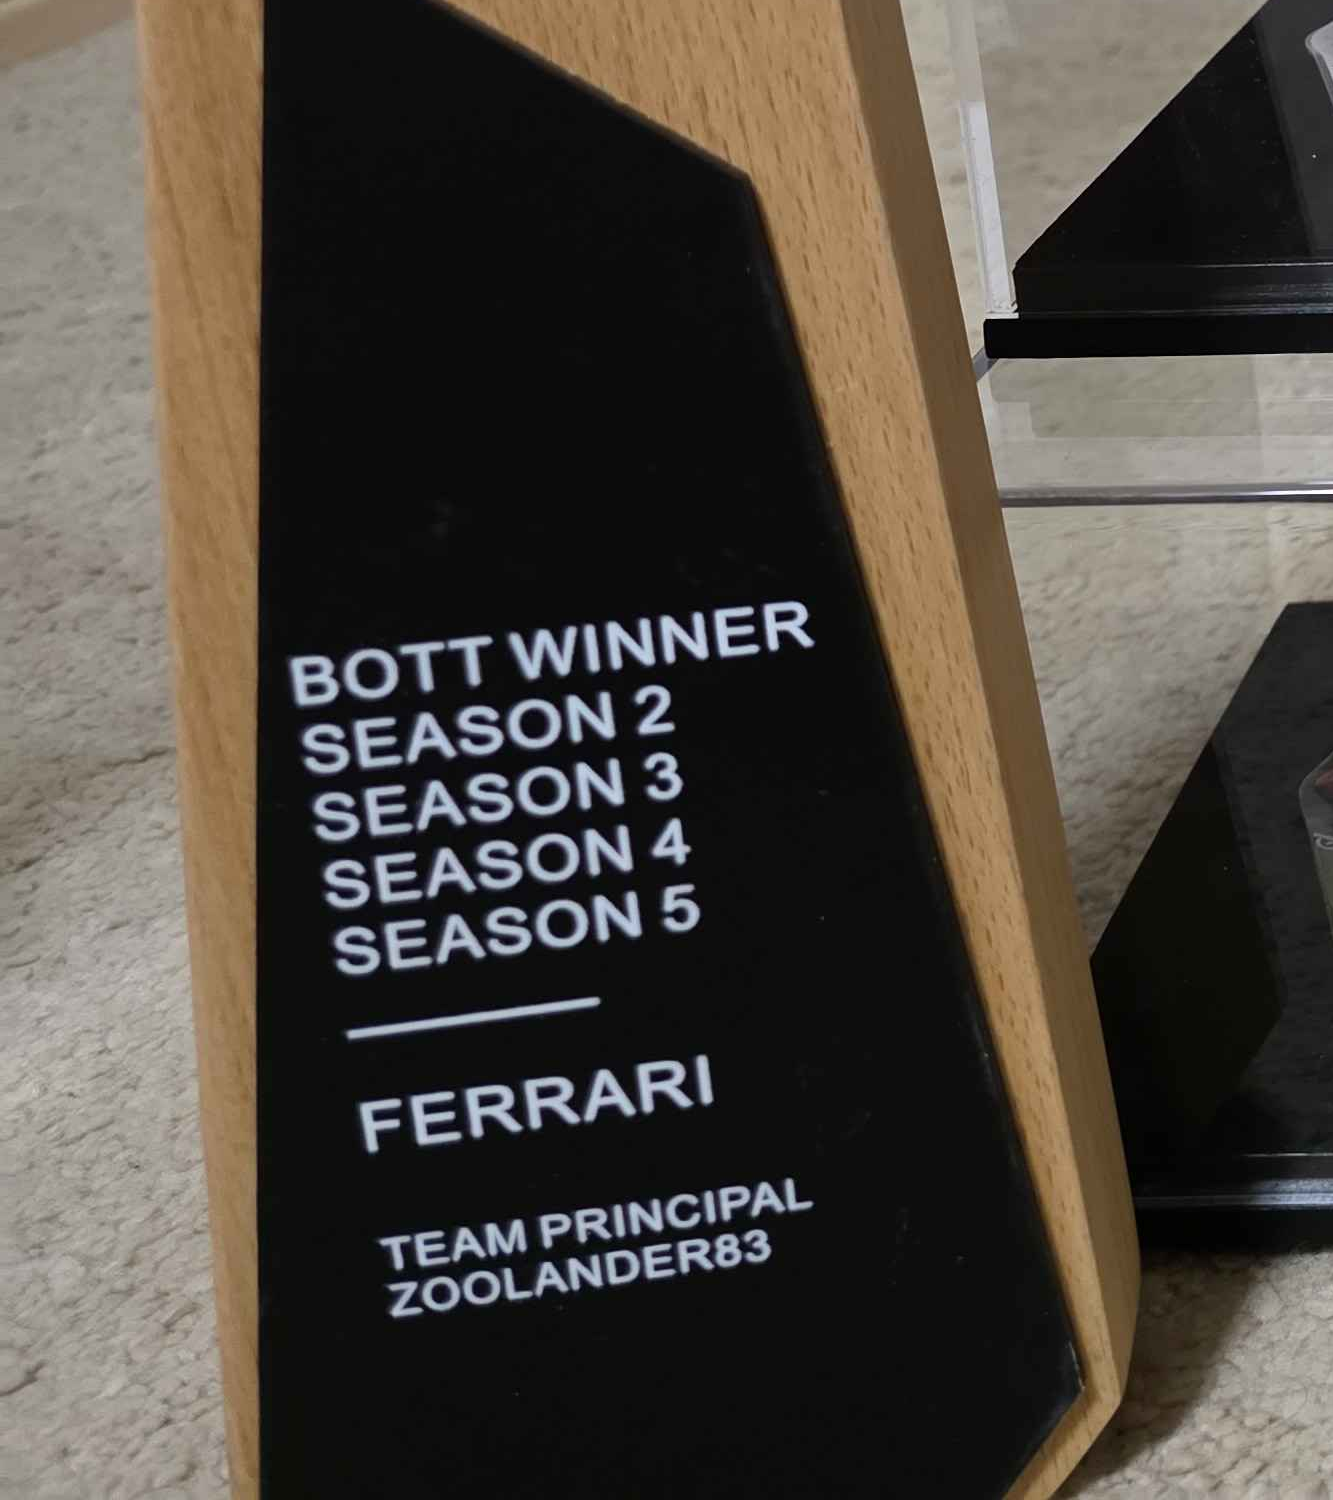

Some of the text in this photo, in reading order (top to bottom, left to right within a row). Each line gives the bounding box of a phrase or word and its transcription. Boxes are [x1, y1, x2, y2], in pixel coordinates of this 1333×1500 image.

[289, 599, 816, 707] BOTT WINNER
[300, 683, 677, 775] SEASON 2
[310, 751, 685, 843] SEASON 3
[321, 816, 693, 911] SEASON 4
[332, 882, 703, 978] SEASON 5
[357, 1053, 716, 1155] FERRARI
[376, 1176, 815, 1271] TEAM PRINCIPAL
[387, 1228, 775, 1320] ZOOLANDER83
